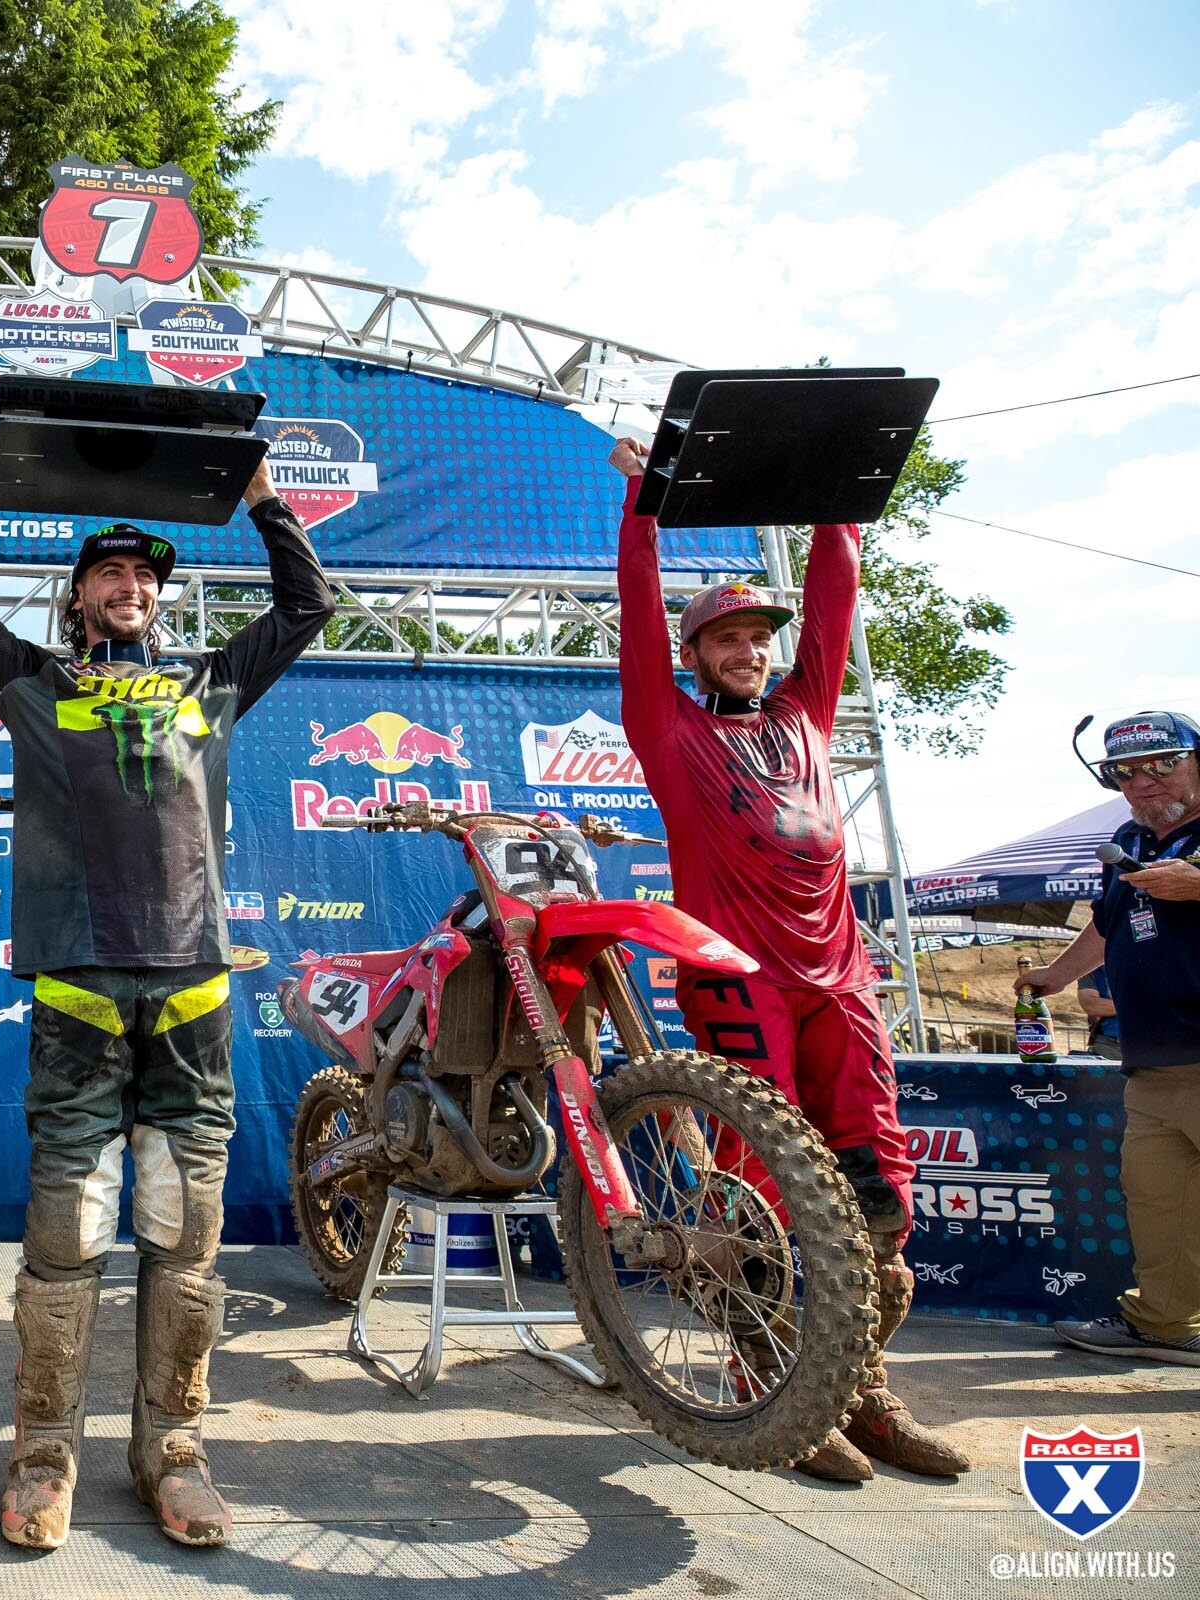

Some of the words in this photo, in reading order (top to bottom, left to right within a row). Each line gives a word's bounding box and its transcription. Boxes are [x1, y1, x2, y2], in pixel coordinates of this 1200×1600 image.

[60, 167, 115, 179] FIRST
[122, 172, 183, 186] PLACE
[75, 179, 108, 189] 450
[113, 182, 169, 195] CLASS
[3, 304, 61, 318] LUCAS
[64, 305, 91, 319] OIL
[160, 317, 205, 330] TWISTED
[205, 318, 224, 332] TEA
[152, 335, 239, 351] SOUTHWICK
[160, 355, 234, 364] NATIONAL
[310, 441, 332, 459] TEA
[270, 465, 350, 484] UTHWICK
[281, 492, 344, 501] TIONAL
[718, 597, 741, 609] Red
[77, 674, 183, 700] THOR
[1112, 725, 1135, 736] LUCAS
[542, 752, 646, 784] LUCA
[291, 779, 390, 831] Red
[395, 781, 491, 831] Bll
[534, 792, 566, 807] OIL
[573, 793, 657, 809] PRODUCT
[505, 843, 585, 894] 94
[915, 878, 954, 891] LUCAS
[908, 885, 999, 907] OTOCROSS
[298, 902, 365, 919] THOR
[332, 958, 362, 968] HONDA
[657, 967, 677, 979] KT
[505, 955, 545, 1030] SHOWA
[311, 980, 362, 1025] 94
[654, 1000, 677, 1008] GAS
[267, 1009, 277, 1022] 2
[694, 978, 768, 1059] FO
[254, 1029, 292, 1037] RECOVERY
[561, 1091, 611, 1194] DUNLOP
[906, 1129, 968, 1163] OIL
[414, 1234, 435, 1245] Taurin
